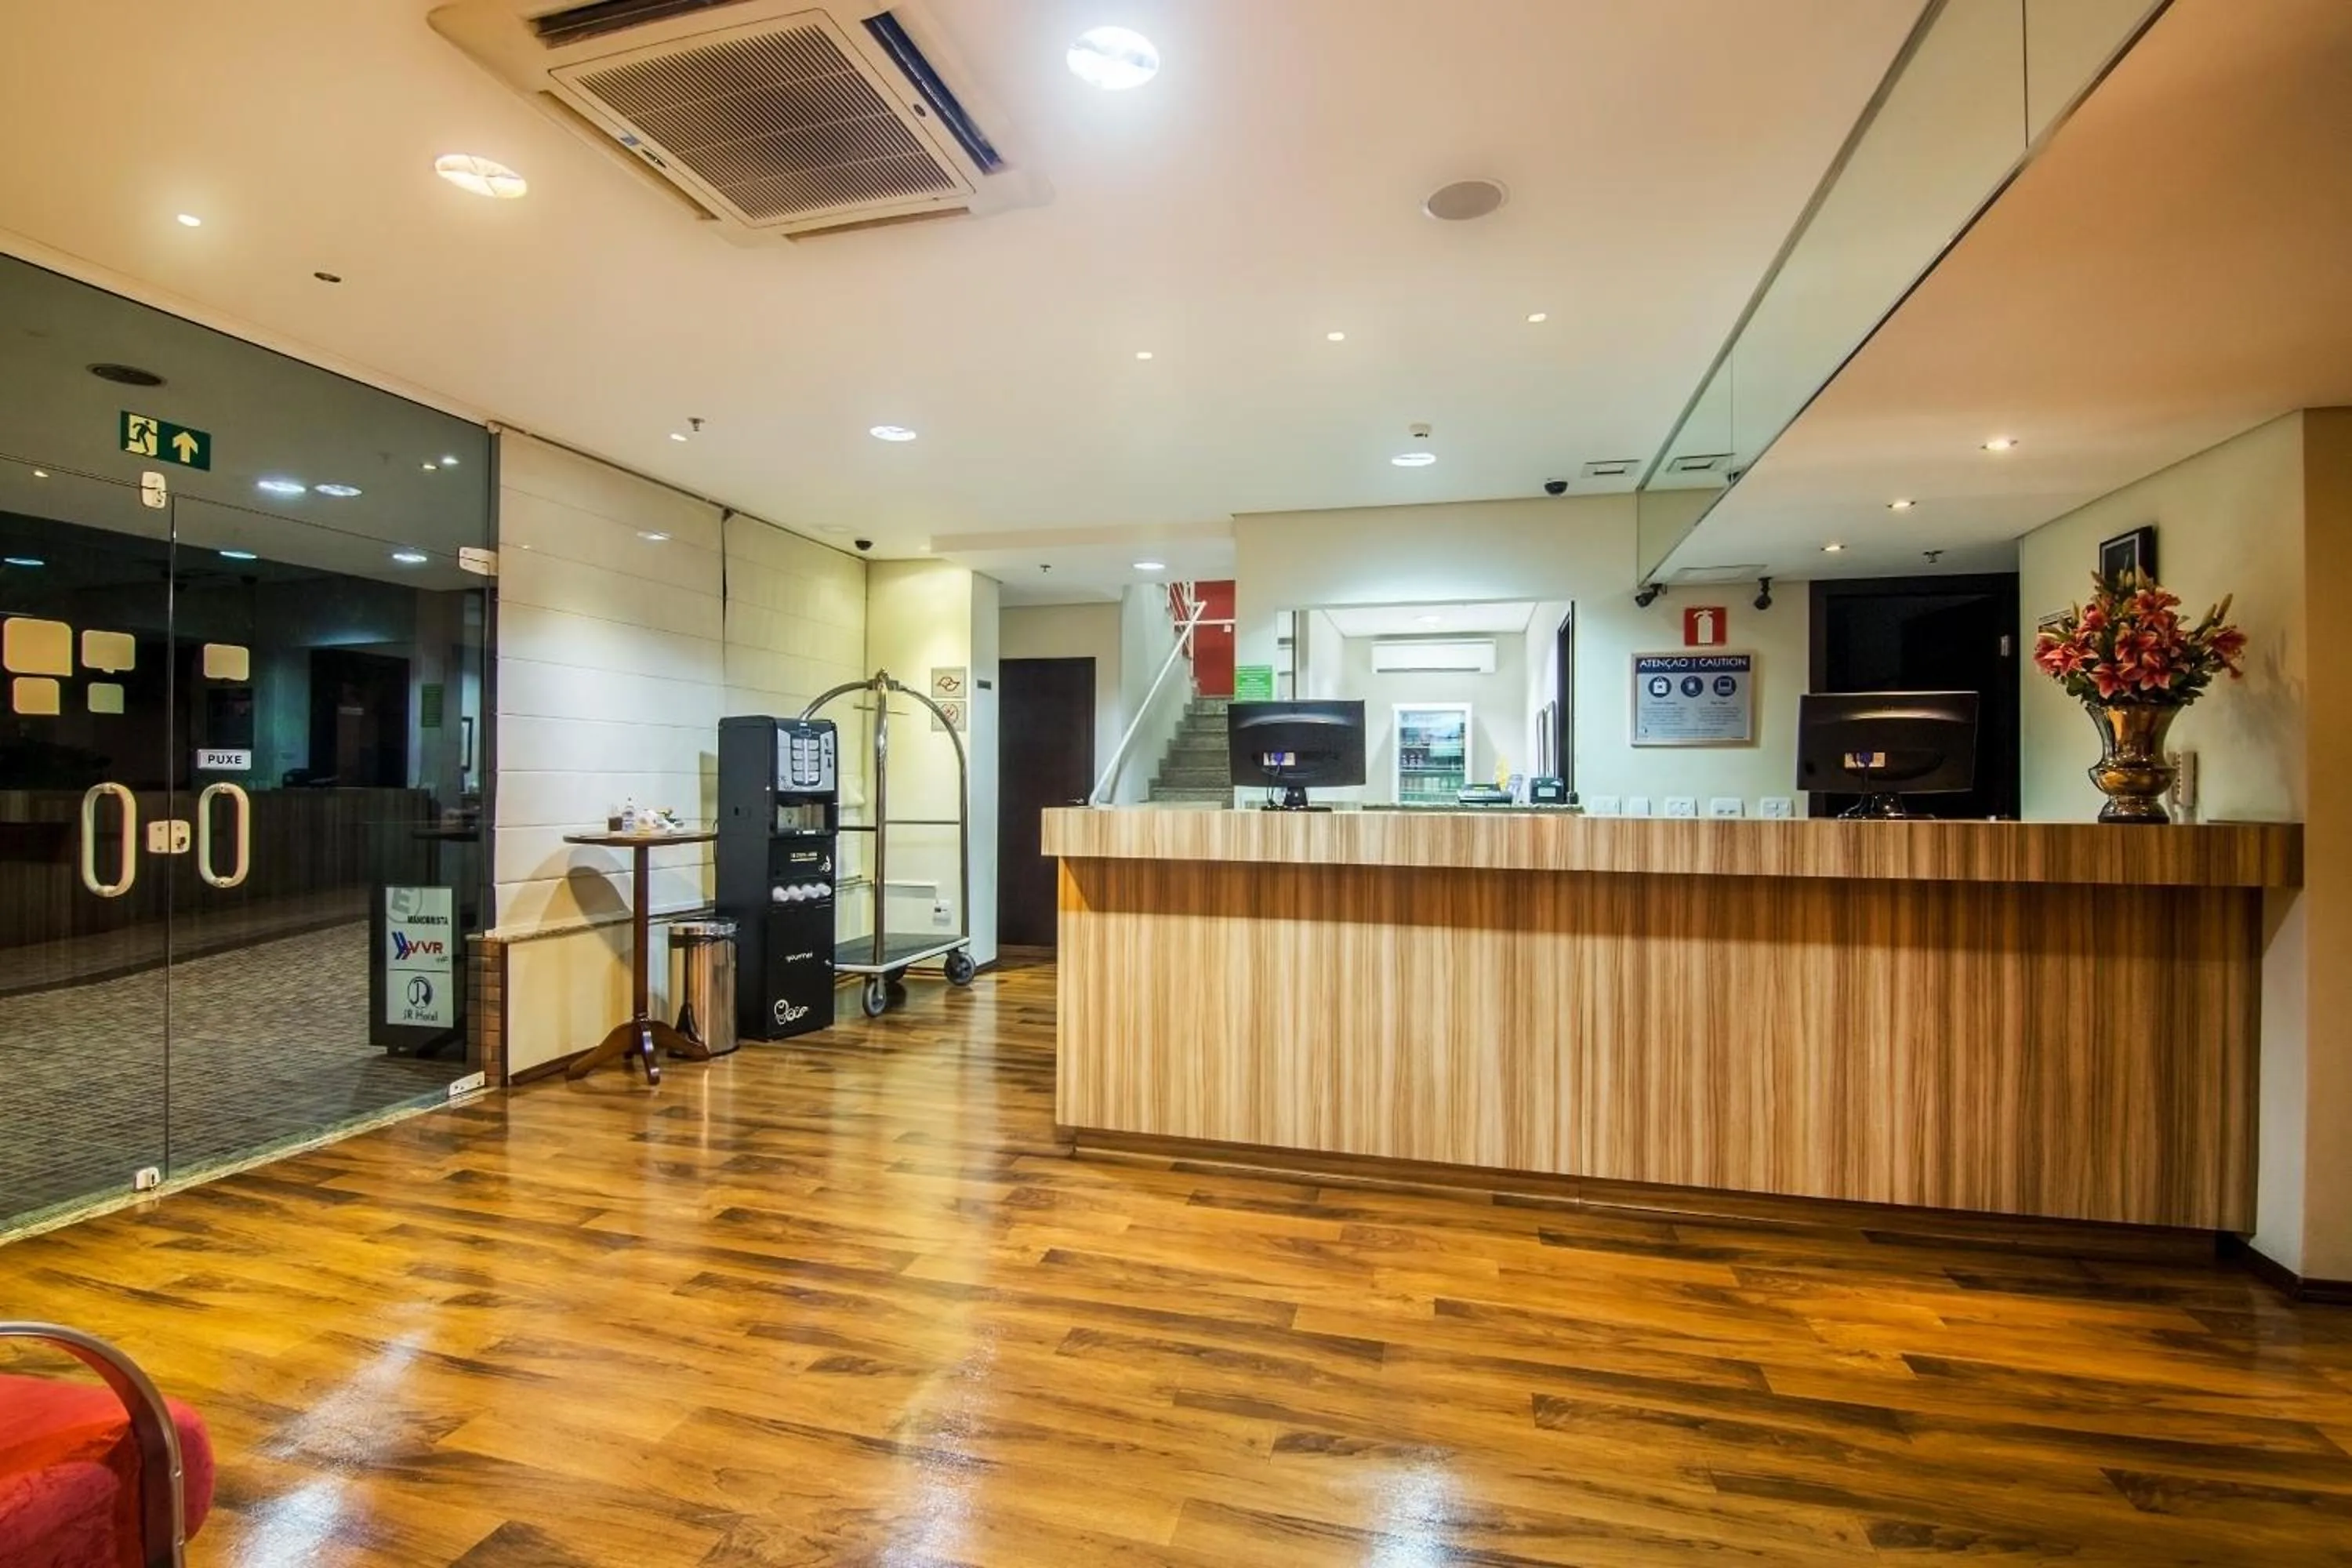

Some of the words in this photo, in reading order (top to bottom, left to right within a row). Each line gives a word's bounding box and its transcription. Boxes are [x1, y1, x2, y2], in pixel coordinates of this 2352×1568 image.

[1699, 656, 1747, 667] CAUTION
[208, 754, 243, 764] PUXE
[403, 1009, 413, 1020] JR
[416, 1010, 438, 1021] Hotel
